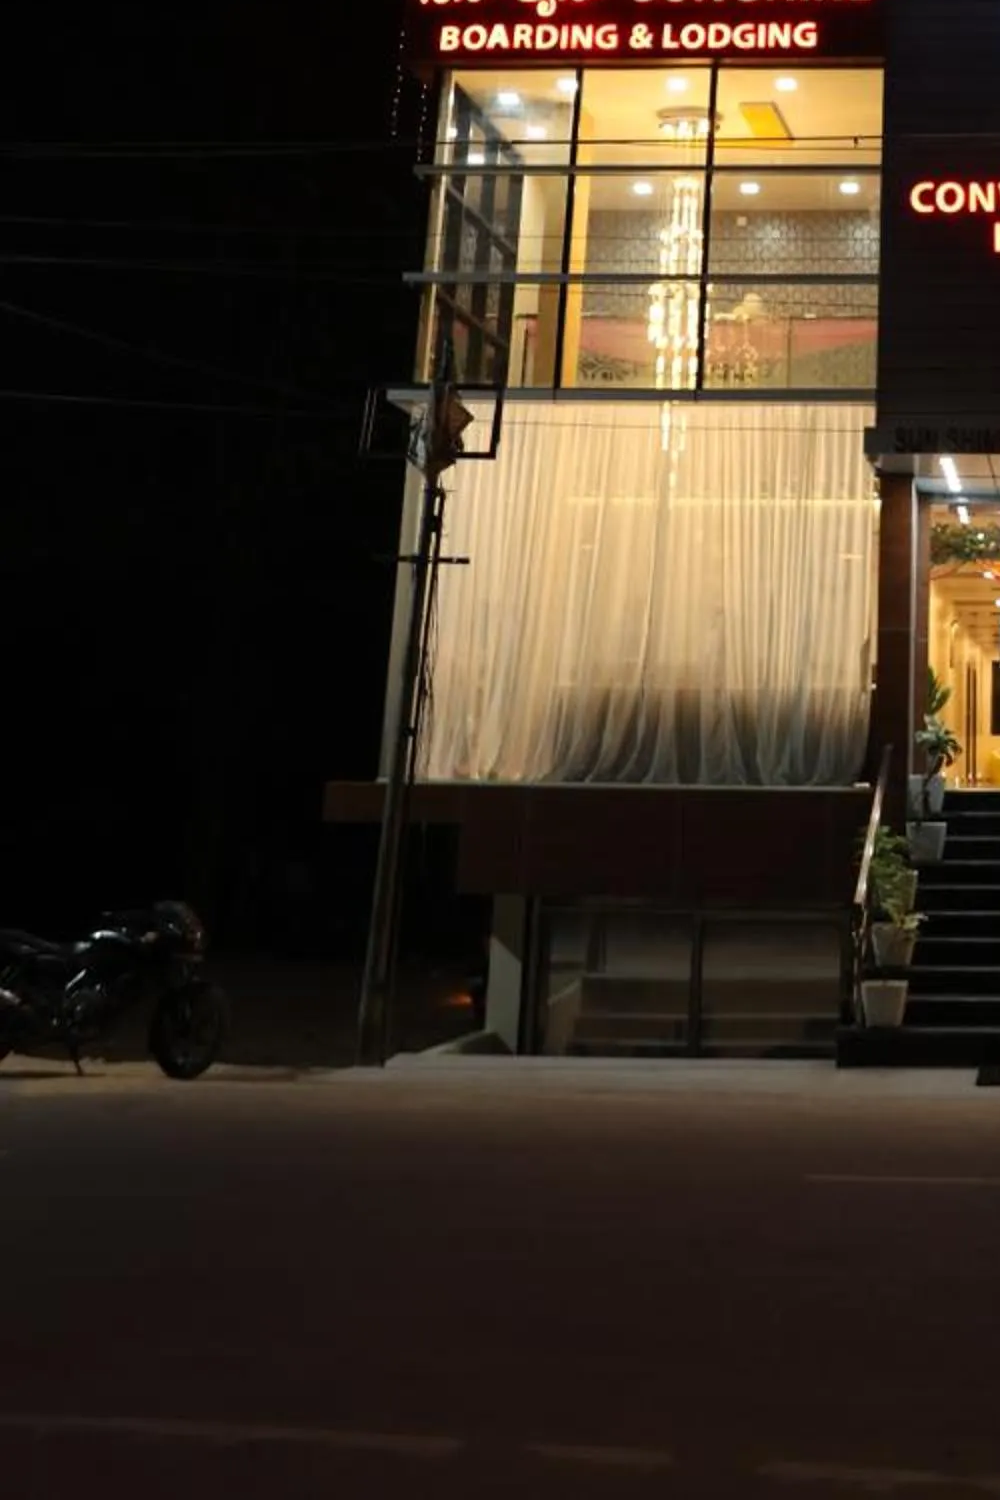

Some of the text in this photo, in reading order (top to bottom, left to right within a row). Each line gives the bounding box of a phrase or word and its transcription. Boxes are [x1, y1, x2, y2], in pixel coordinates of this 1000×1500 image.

[439, 21, 818, 51] BOARDING & LODGING
